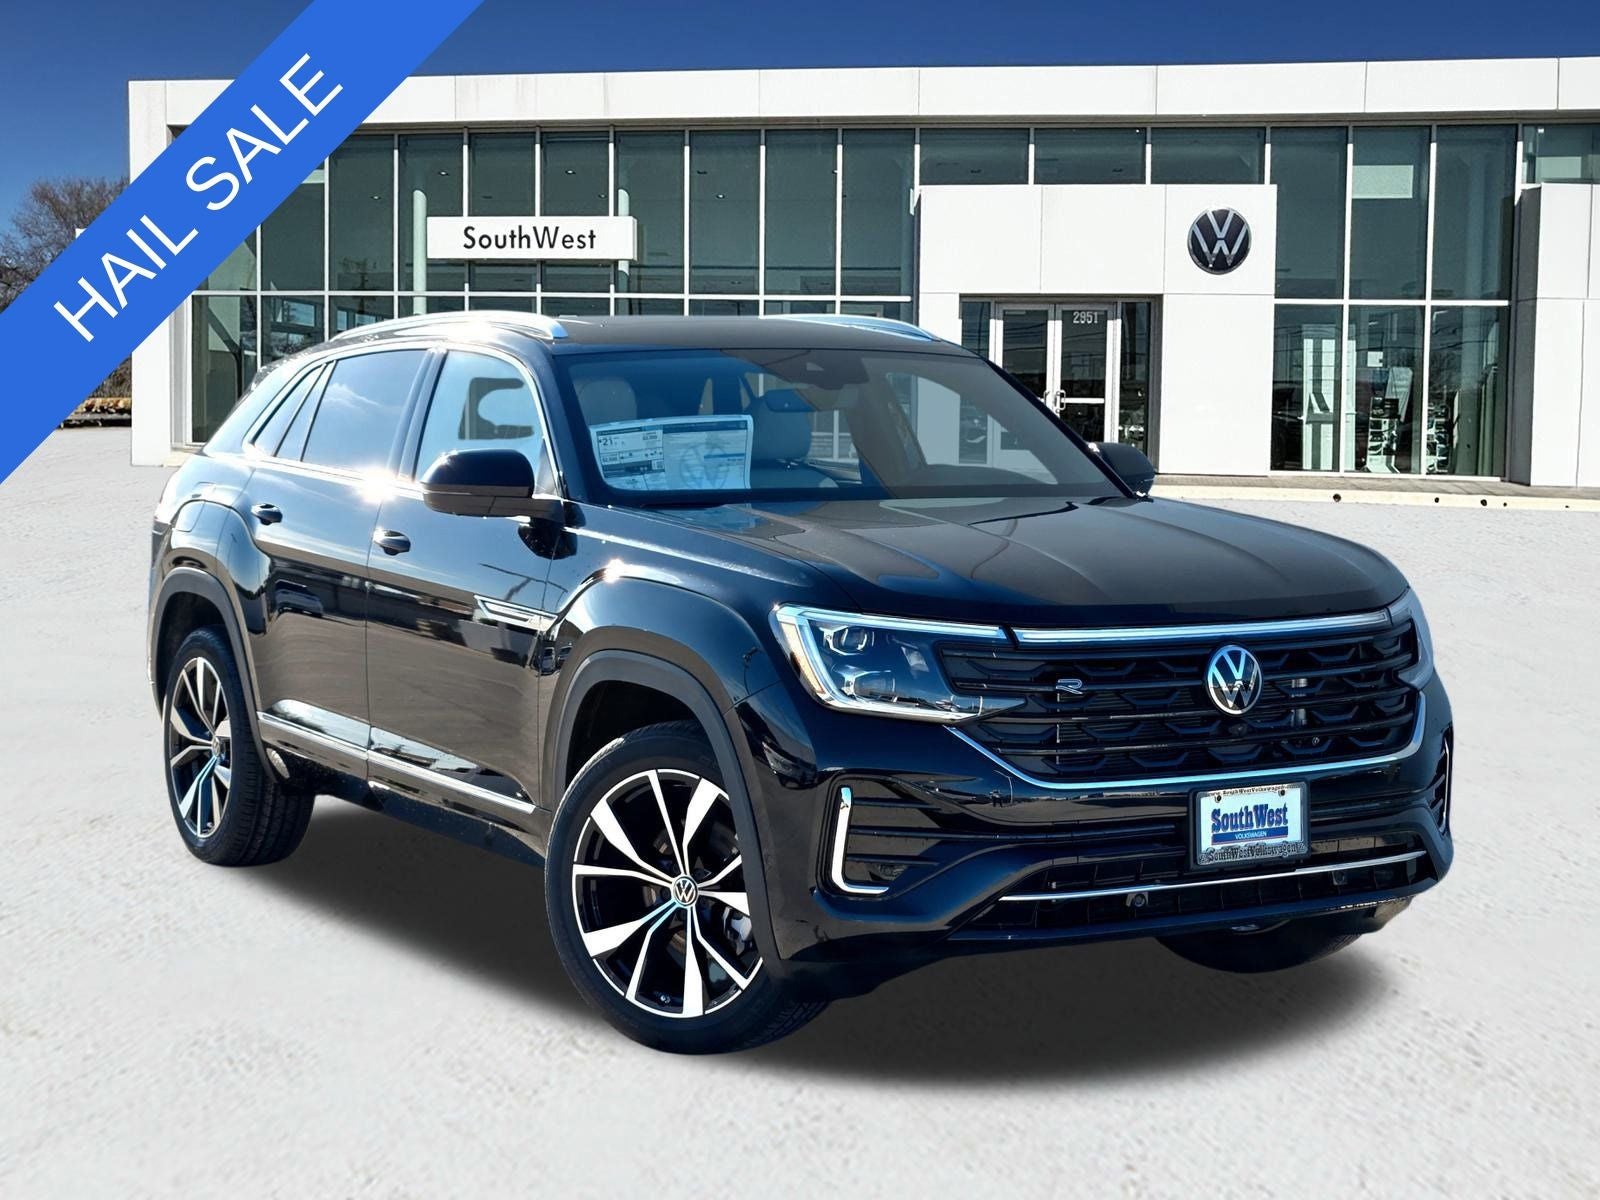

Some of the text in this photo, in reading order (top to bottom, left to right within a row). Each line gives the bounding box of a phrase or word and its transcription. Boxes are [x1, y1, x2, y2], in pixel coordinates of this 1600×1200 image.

[463, 225, 596, 249] SouthWest
[1191, 208, 1249, 267] VW
[1072, 311, 1098, 324] 2951
[1211, 649, 1259, 708] VW
[1211, 802, 1288, 832] SouthWest
[1235, 831, 1267, 840] VOLKSWAGEN
